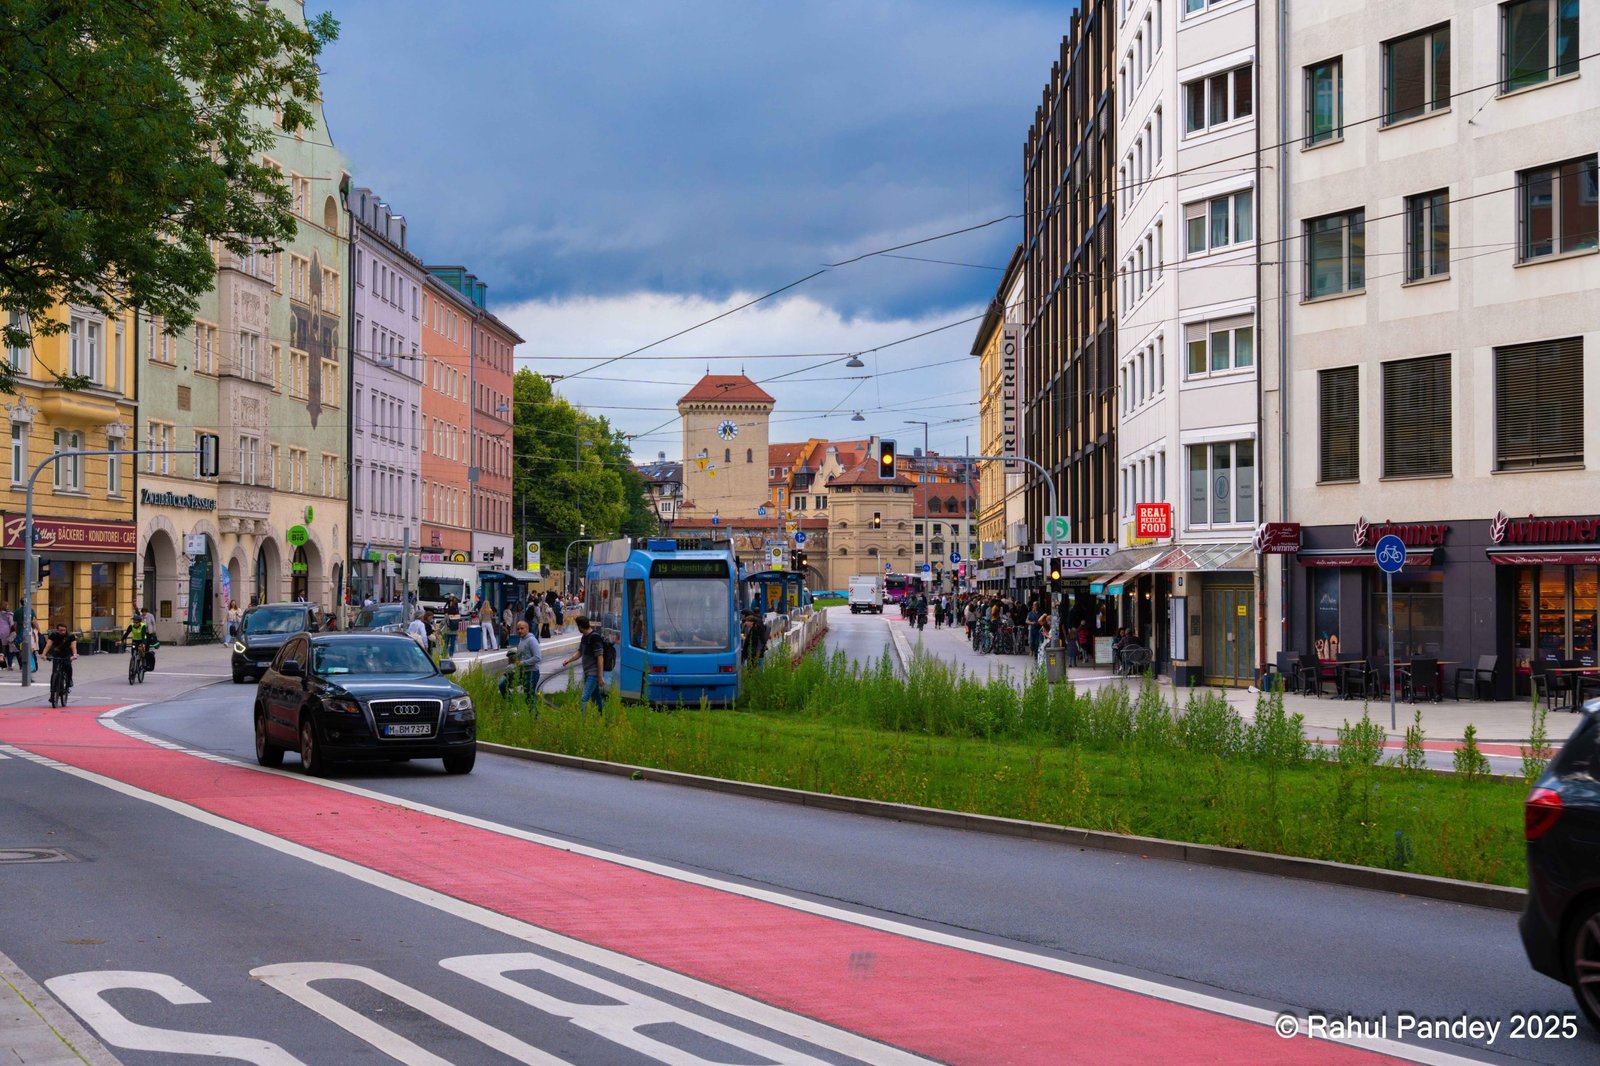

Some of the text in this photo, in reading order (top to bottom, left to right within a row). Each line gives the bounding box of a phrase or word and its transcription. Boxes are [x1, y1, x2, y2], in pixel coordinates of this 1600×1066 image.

[1140, 507, 1167, 517] REAL
[1140, 523, 1167, 533] FOOD
[1368, 519, 1448, 545] wimmer
[1508, 513, 1600, 544] wimmer
[58, 525, 136, 544] BÄCKEREI KONDITOREI CAFÉ
[1042, 547, 1110, 556] BREITER
[1271, 543, 1300, 553] wimmer
[658, 563, 668, 573] 19
[1061, 559, 1092, 567] HOF
[389, 724, 430, 734] M BM 7373
